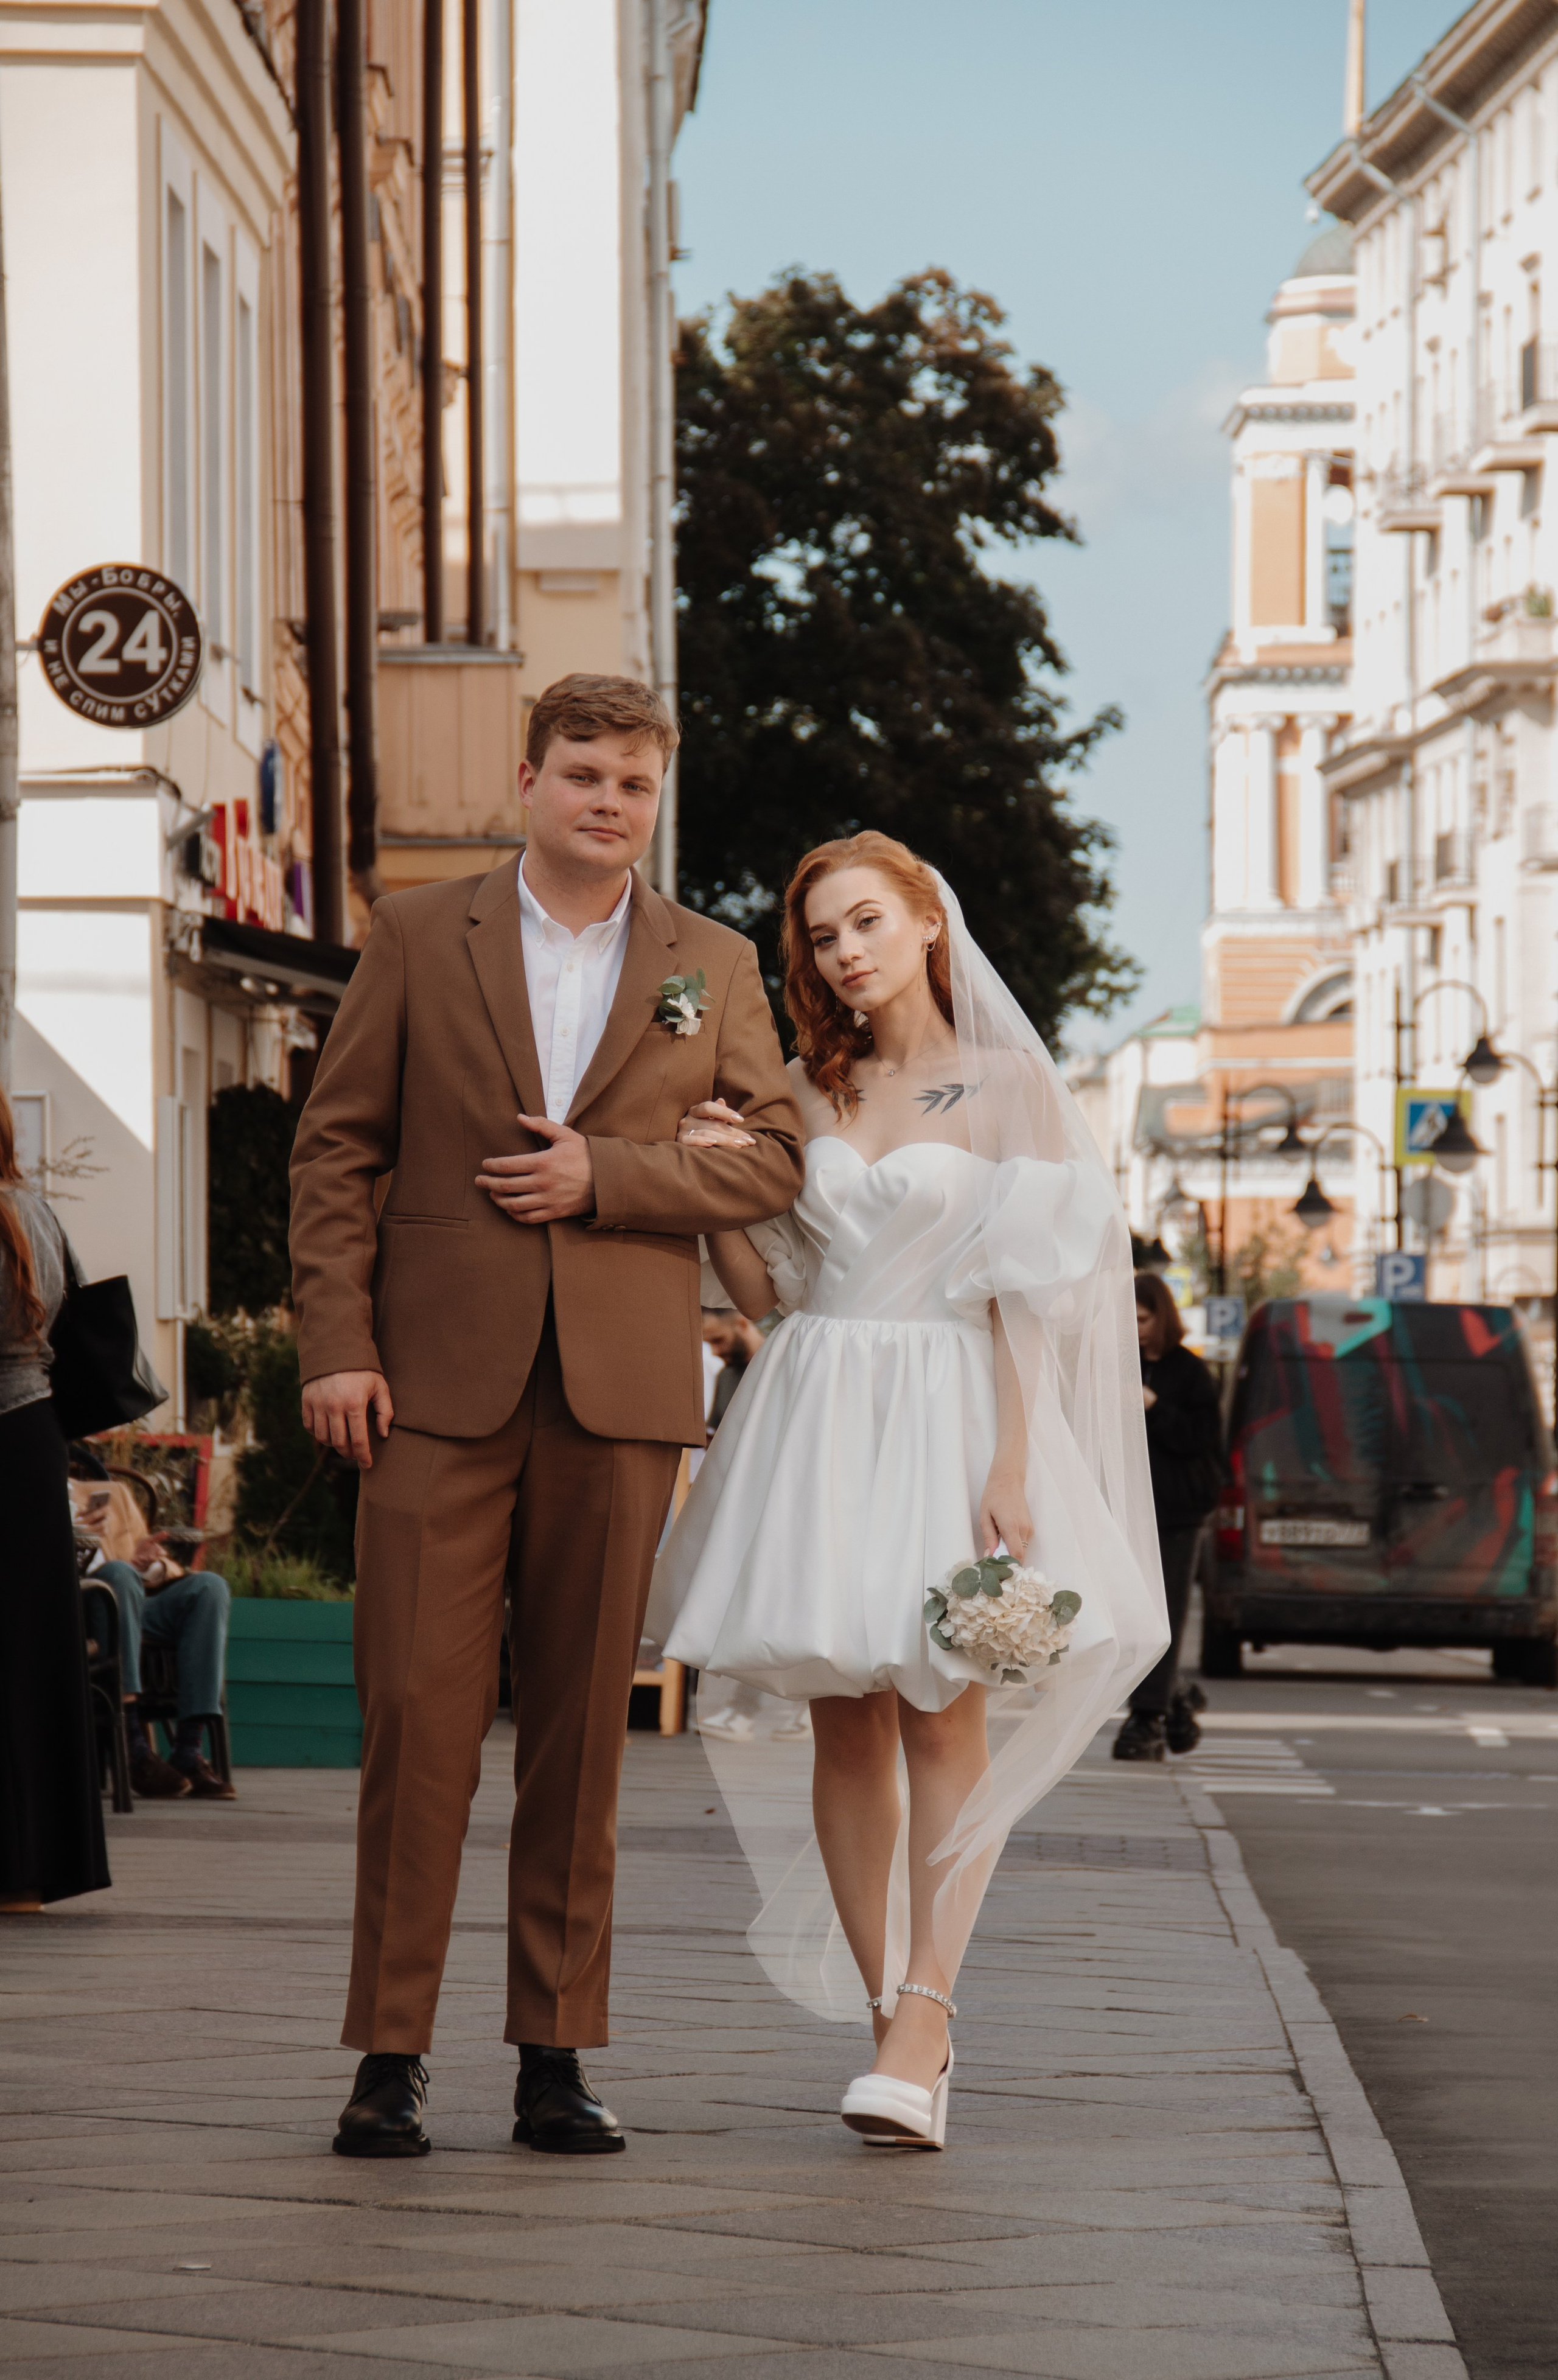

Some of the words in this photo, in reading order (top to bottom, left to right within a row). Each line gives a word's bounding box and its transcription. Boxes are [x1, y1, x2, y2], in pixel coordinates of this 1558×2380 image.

[52, 580, 88, 616] МЫ
[44, 639, 58, 654] И
[77, 609, 168, 675] 24
[47, 660, 70, 689] НЕ
[134, 636, 196, 718] СУТКАМИ
[69, 689, 126, 722] СПИМ
[1385, 1256, 1416, 1299] P
[1212, 1302, 1237, 1335] P
